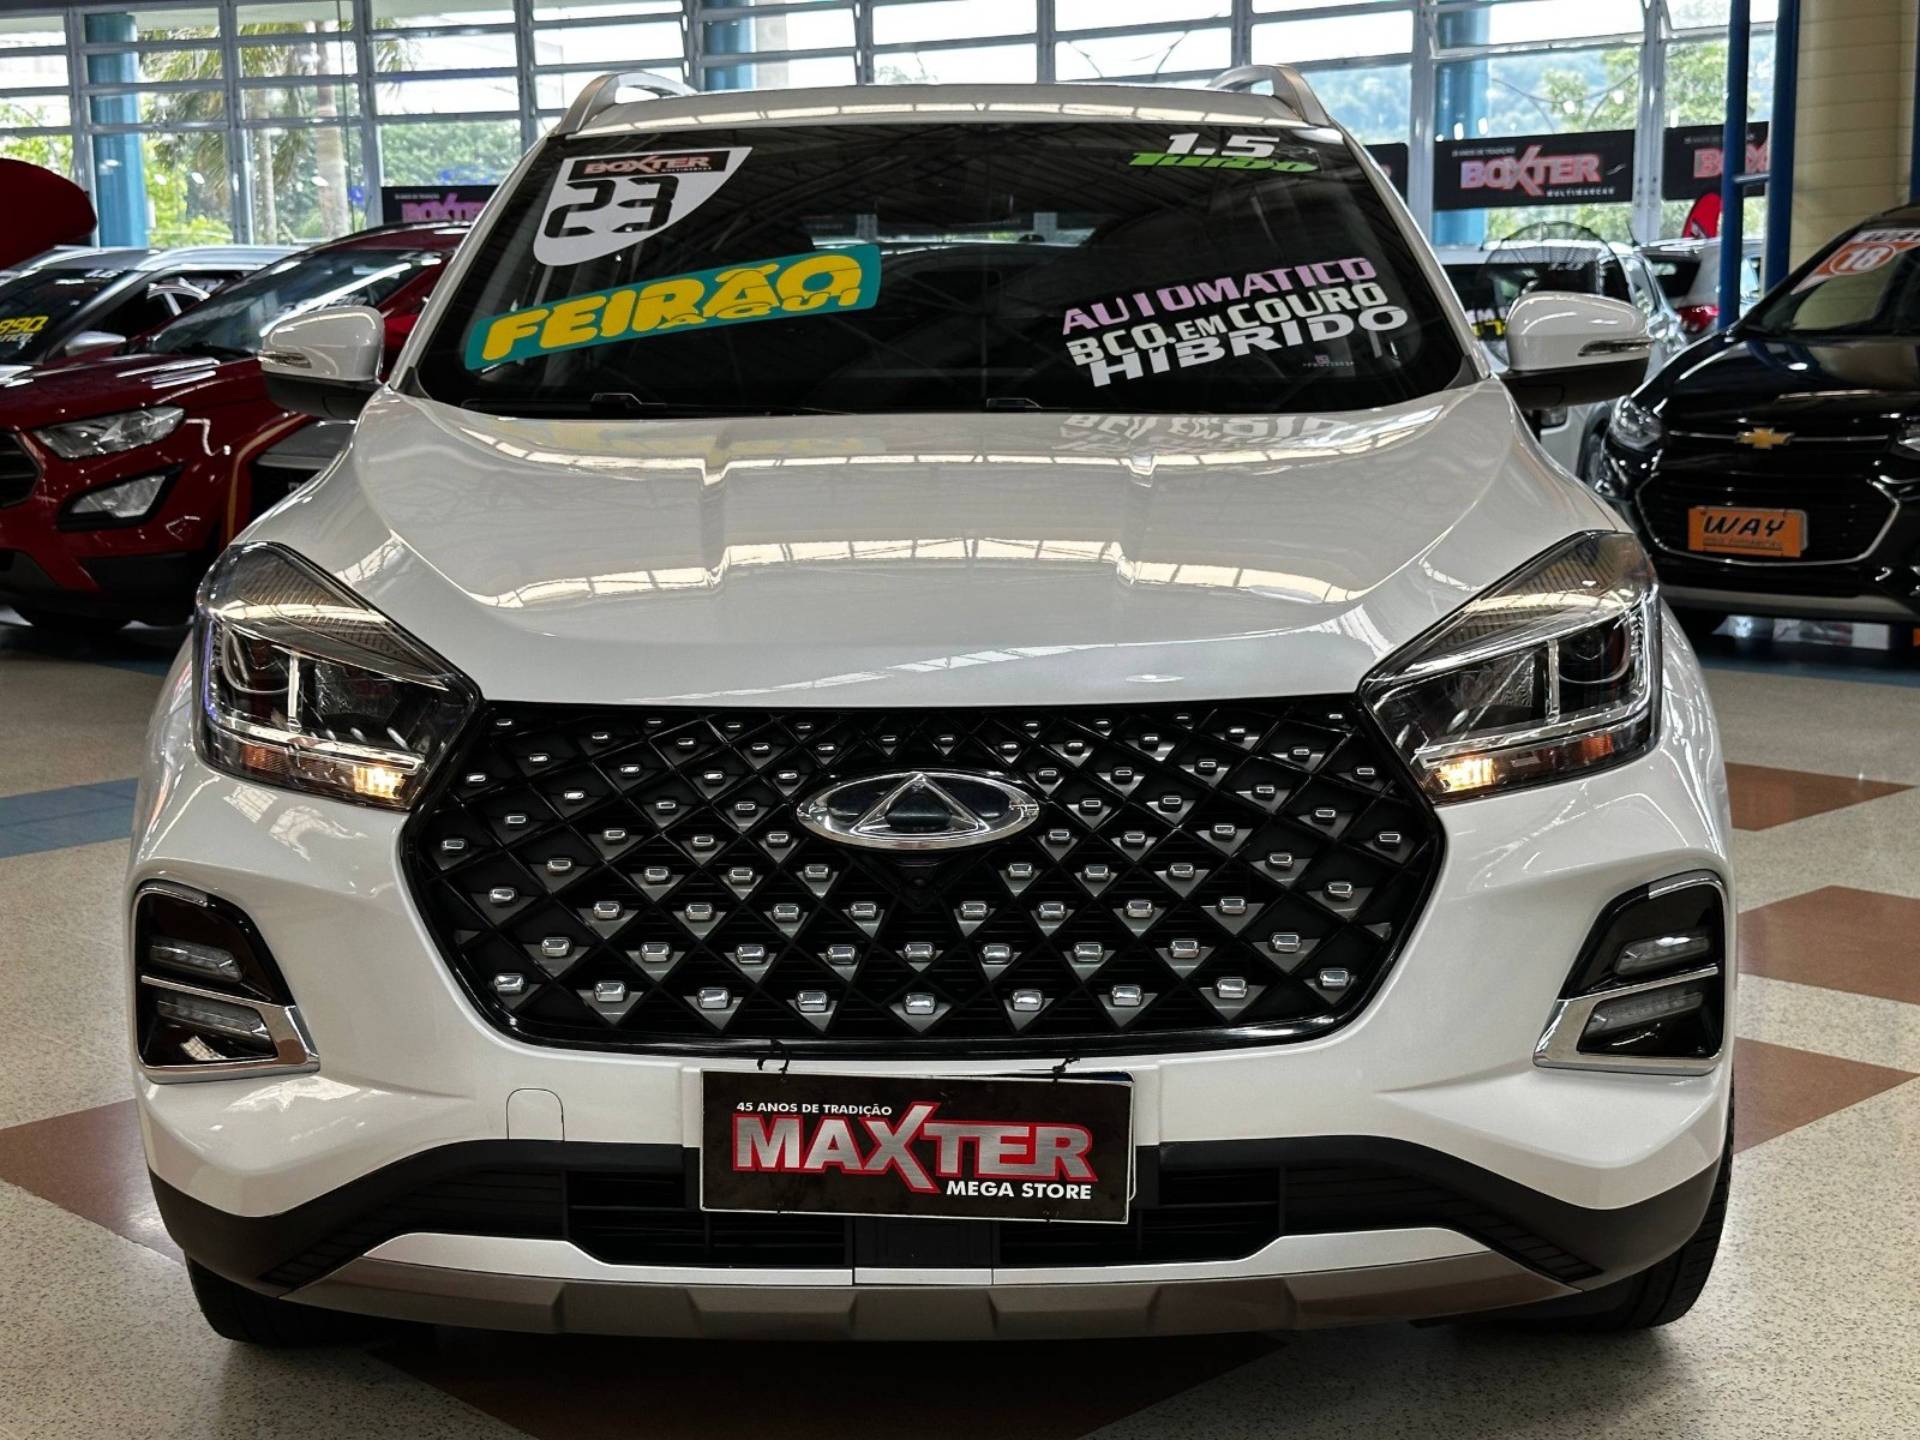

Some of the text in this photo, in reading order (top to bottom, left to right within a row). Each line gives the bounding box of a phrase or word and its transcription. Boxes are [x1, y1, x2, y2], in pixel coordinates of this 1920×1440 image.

[584, 155, 711, 174] BOXTER
[1166, 133, 1280, 157] 1.5
[1460, 144, 1602, 196] BOXTER
[544, 175, 679, 238] 23
[482, 255, 862, 361] FEIRÃO
[1175, 314, 1228, 341] EM
[1226, 282, 1388, 329] COURO
[1089, 305, 1408, 388] HIBRIDO
[1703, 515, 1785, 537] WAY
[736, 1102, 893, 1117] 45 ANOS DE TRADIÇÃO
[733, 1101, 1098, 1193] MAXTER
[946, 1180, 1092, 1200] MEGA STORE
